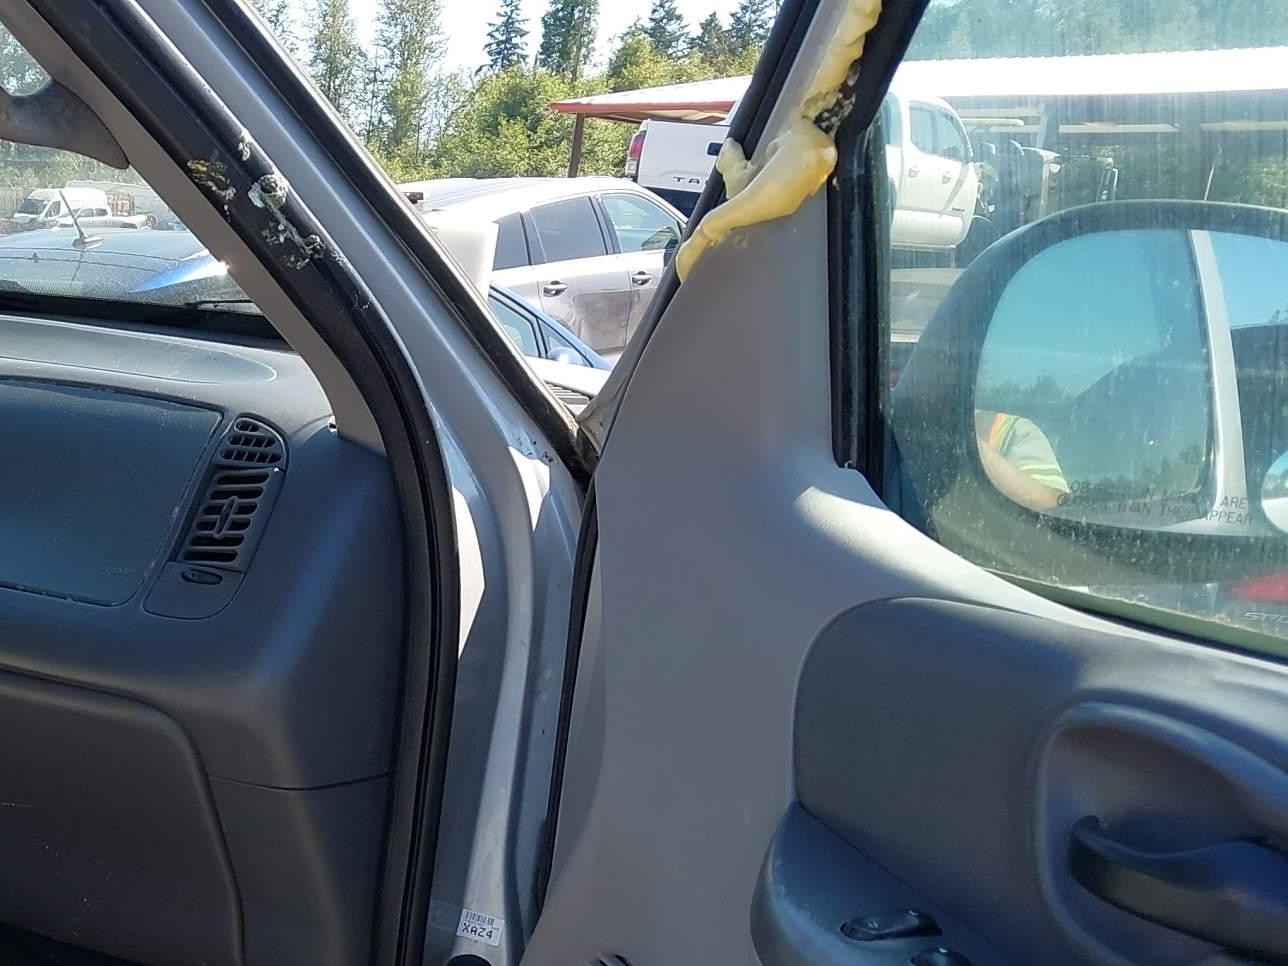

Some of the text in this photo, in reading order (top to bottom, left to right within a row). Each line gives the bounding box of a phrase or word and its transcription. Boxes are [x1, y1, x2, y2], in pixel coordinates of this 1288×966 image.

[673, 176, 700, 184] TA
[1219, 495, 1249, 509] ARE
[1203, 509, 1254, 528] APPEAR
